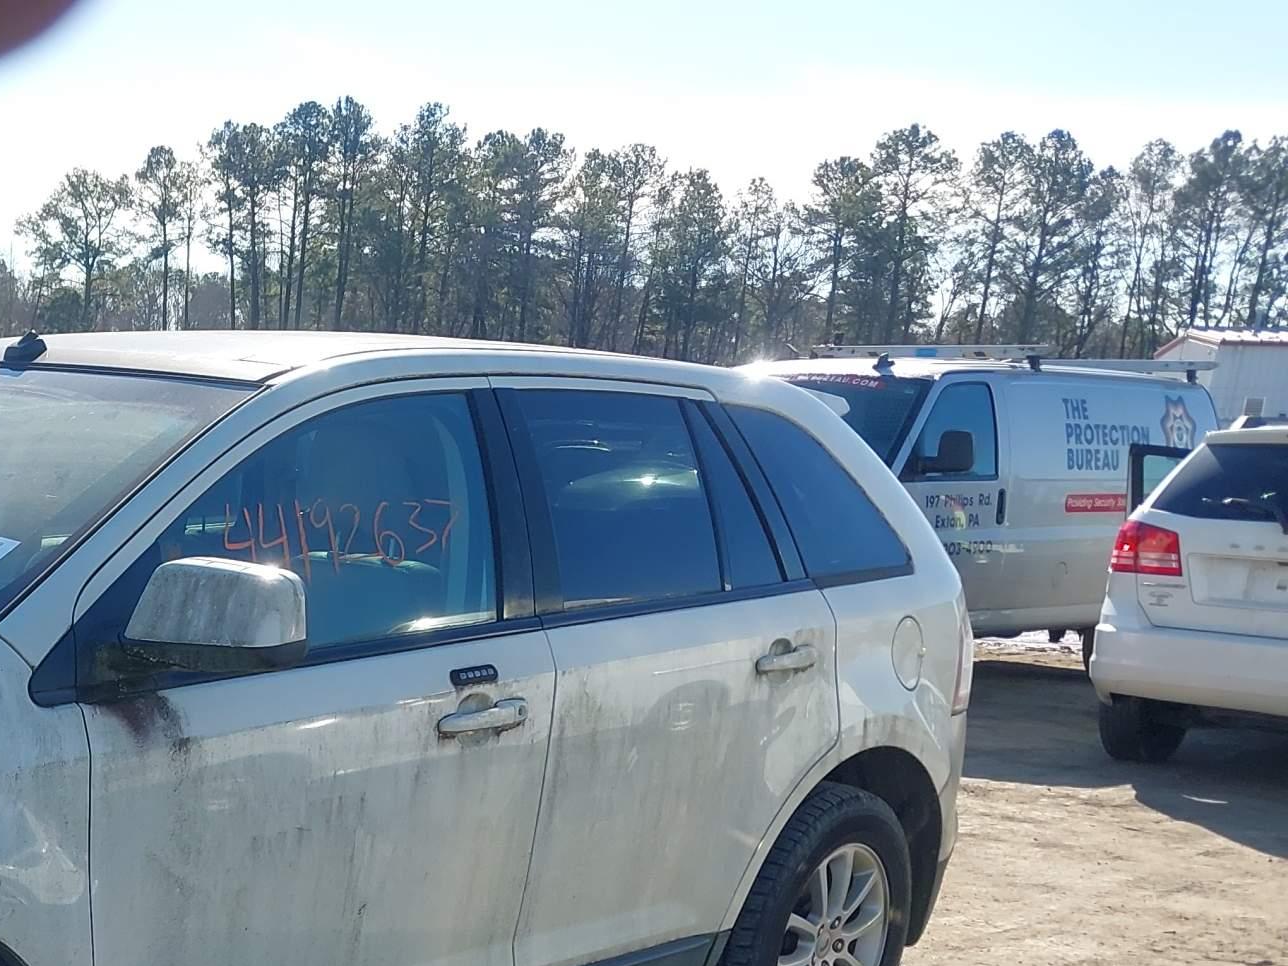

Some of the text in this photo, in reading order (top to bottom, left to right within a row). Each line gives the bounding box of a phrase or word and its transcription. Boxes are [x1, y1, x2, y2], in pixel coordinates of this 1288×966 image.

[1062, 398, 1089, 420] THE
[1065, 423, 1150, 445] PROTECTION
[1067, 448, 1120, 471] BUREAU
[925, 495, 940, 508] 197
[978, 493, 992, 506] Rd.
[935, 513, 980, 529] Exton, PA
[224, 499, 458, 584] 44192637
